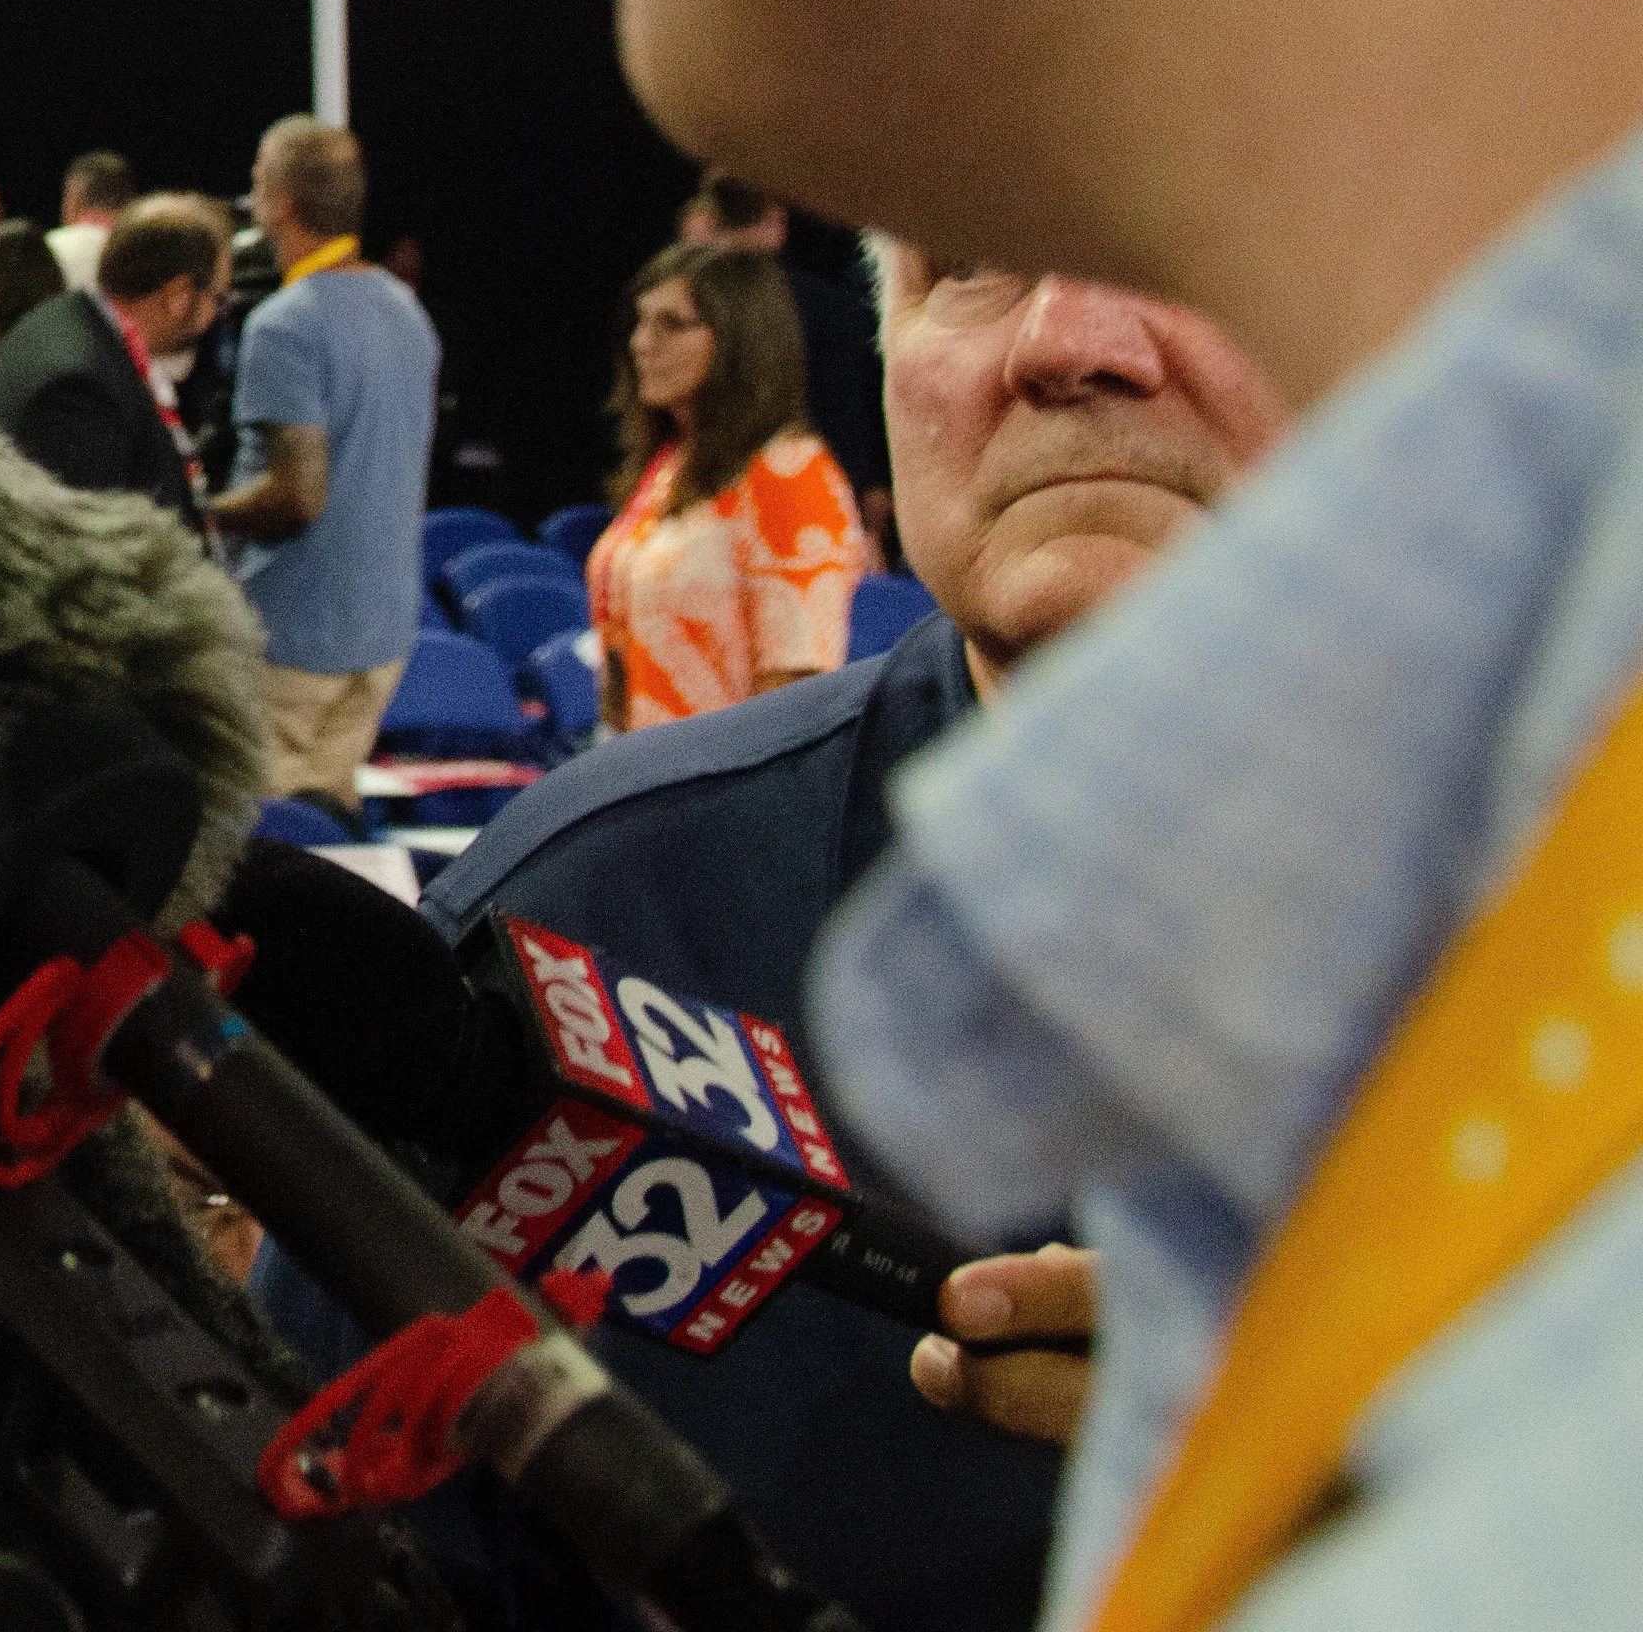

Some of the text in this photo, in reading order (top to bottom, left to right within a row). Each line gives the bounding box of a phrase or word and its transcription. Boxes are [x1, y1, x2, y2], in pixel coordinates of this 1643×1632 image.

[522, 935, 636, 1090] FOX
[616, 977, 779, 1152] 32
[751, 1025, 841, 1179] NEWS
[461, 1116, 622, 1255] FOX
[551, 1156, 771, 1318] 32
[686, 1204, 829, 1345] NEWS
